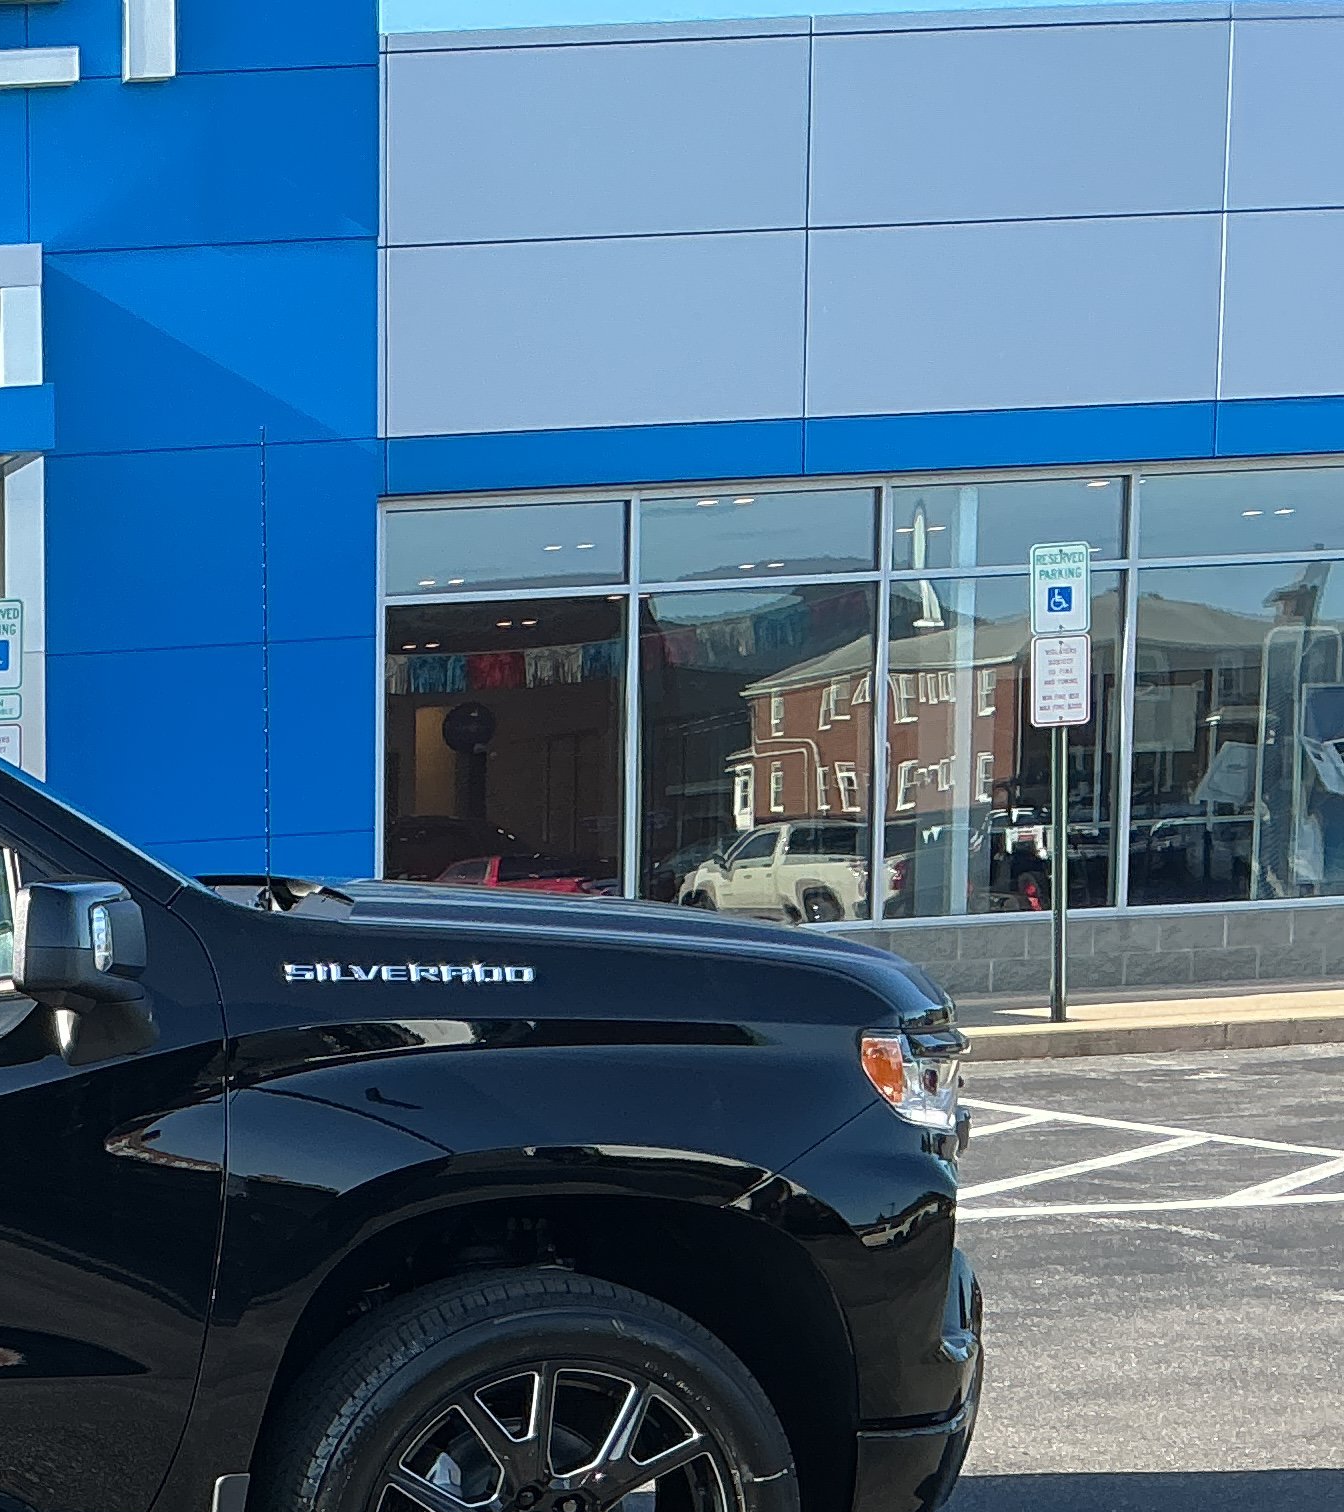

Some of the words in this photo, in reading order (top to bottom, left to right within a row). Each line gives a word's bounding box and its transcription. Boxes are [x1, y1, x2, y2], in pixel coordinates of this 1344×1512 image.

[1036, 551, 1084, 565] RESERVED
[1039, 567, 1082, 580] PARKING
[283, 962, 537, 983] SILVERADO
